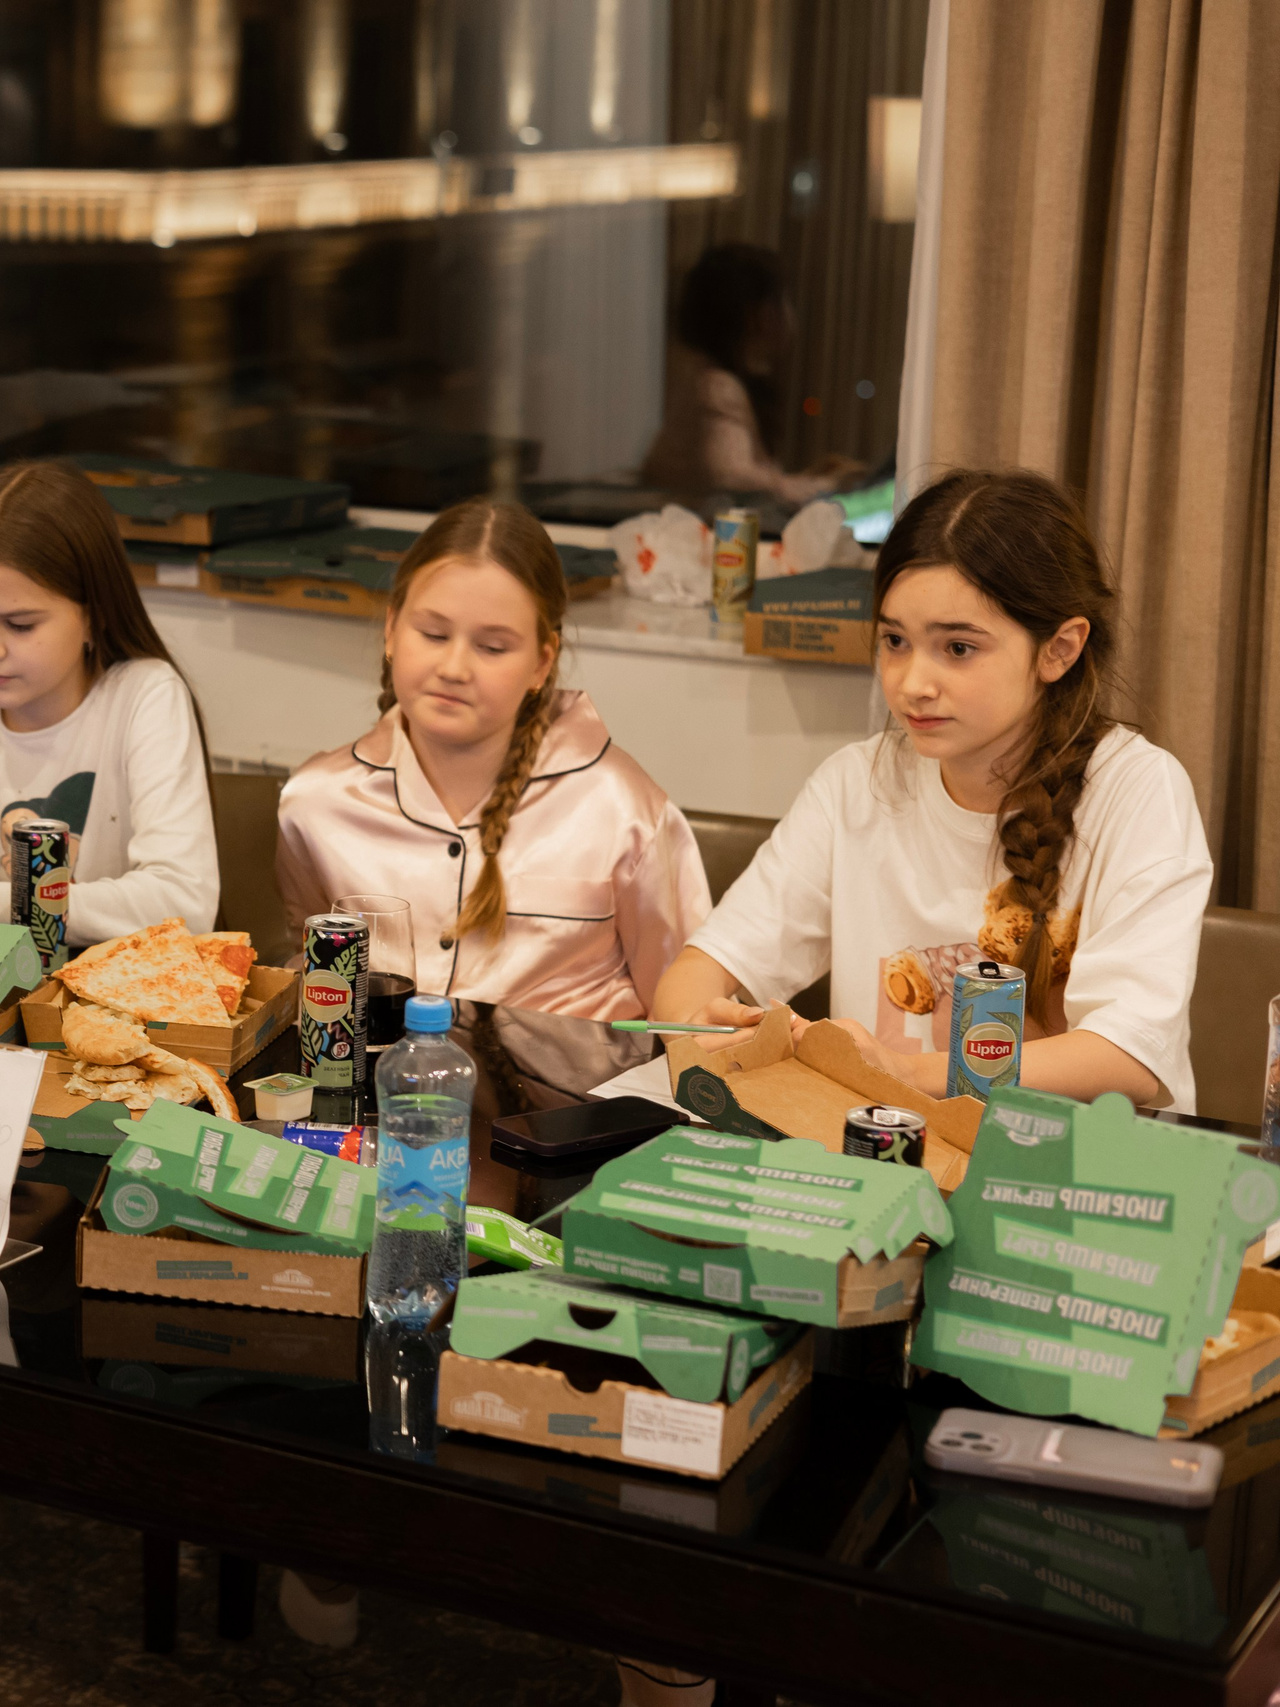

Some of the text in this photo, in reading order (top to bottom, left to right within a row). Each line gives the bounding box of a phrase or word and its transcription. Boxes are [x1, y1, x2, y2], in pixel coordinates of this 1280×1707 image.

[42, 884, 68, 899] Lipto
[307, 988, 344, 1003] Lipton
[970, 1042, 1011, 1057] Lipton
[661, 1154, 855, 1189] ЛЮБИШЬ ПЕРЧИК?
[734, 1200, 851, 1229] ЛЮБИШЬ
[981, 1182, 1168, 1223] ЛЮБИШЬ ПЕРЧИК?
[1003, 1233, 1160, 1287] ЛЮБИШЬ СЫР?
[948, 1272, 1166, 1340] ЛЮБИШЬ ПЕППЕРОНИ?
[1024, 1337, 1135, 1381] ЛЮБИШЬ
